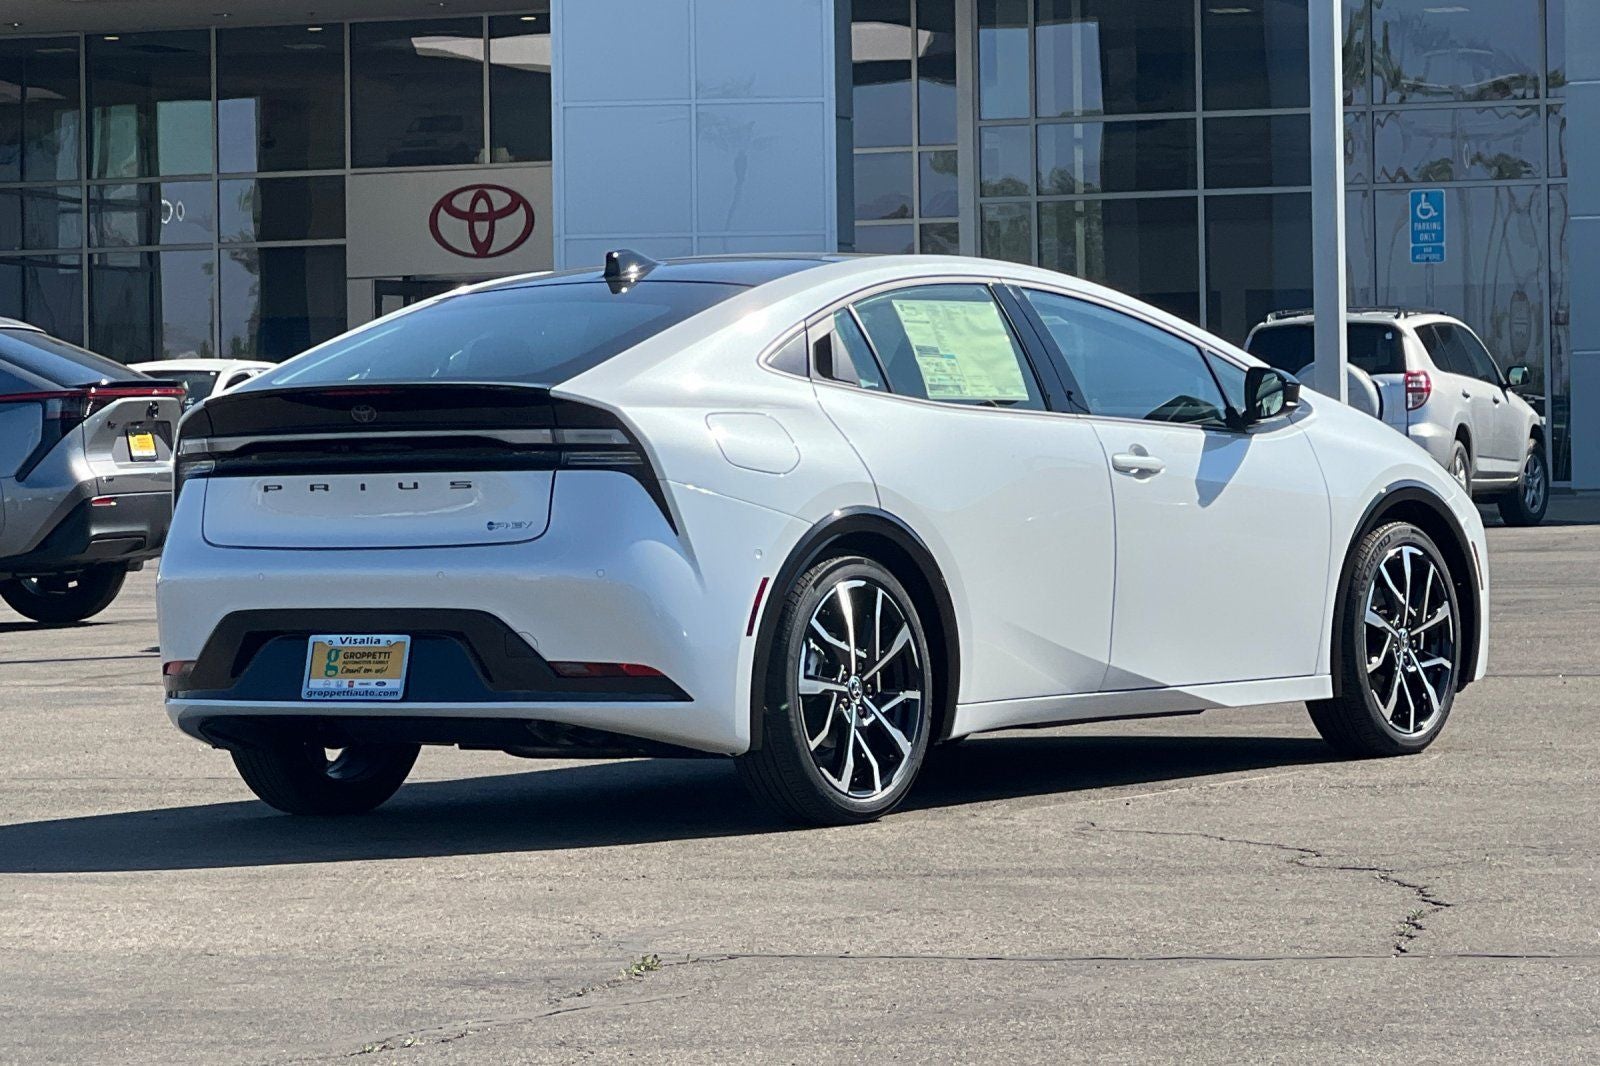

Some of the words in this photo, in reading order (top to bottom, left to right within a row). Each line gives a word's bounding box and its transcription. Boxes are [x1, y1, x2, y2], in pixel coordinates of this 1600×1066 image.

[1414, 222, 1441, 231] PARKING
[1420, 233, 1435, 241] ONLY
[263, 480, 473, 493] PRIUS
[340, 636, 381, 645] Visalia
[343, 651, 390, 660] GROPPETTI
[306, 689, 399, 698] groppettiauto.com
